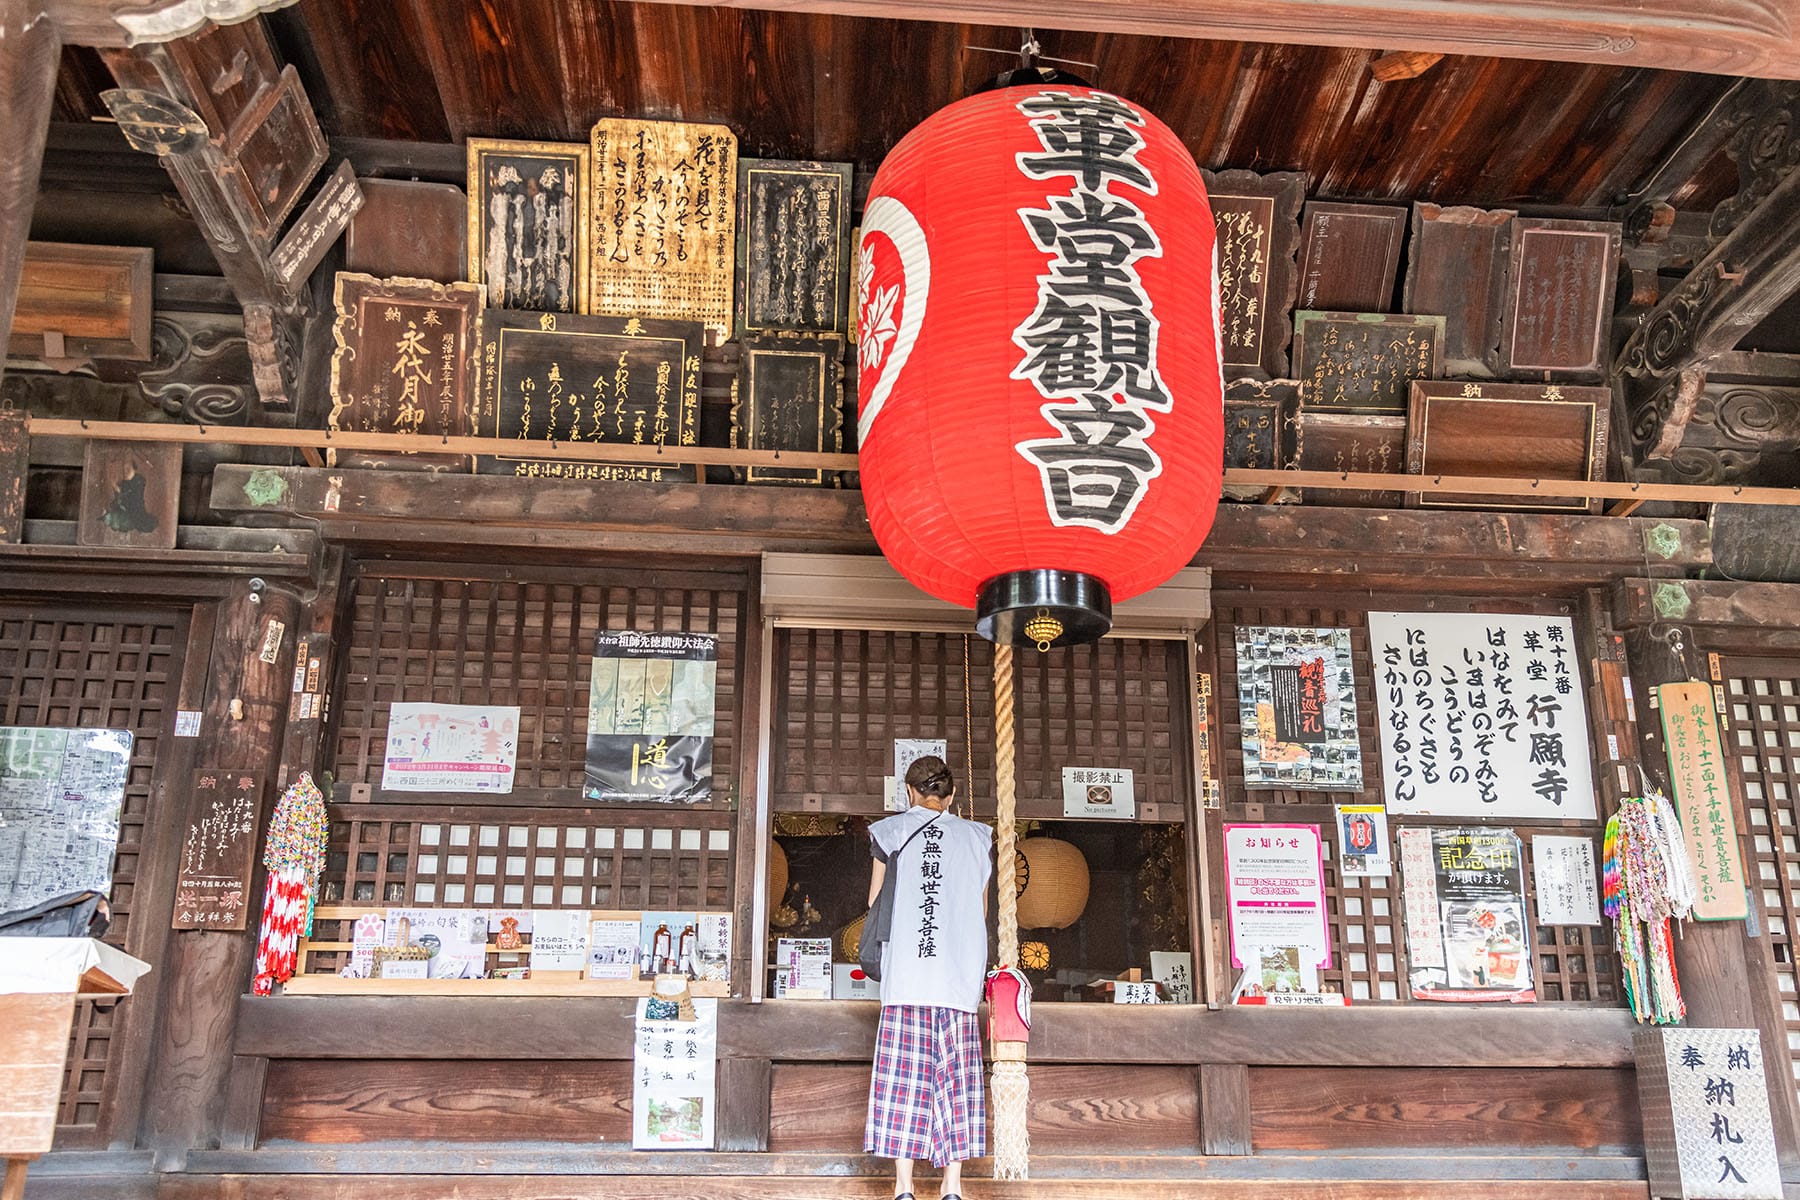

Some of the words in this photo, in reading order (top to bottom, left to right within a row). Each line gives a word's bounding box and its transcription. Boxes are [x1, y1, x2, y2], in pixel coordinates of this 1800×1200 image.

[1299, 660, 1322, 734] 観音巡礼
[1486, 626, 1520, 744] はなをみて
[1522, 631, 1548, 682] 革堂
[1545, 625, 1573, 695] 第十九番
[1382, 643, 1417, 802] さかりなるらん
[1405, 627, 1441, 785] にはのちぐさも
[1439, 664, 1470, 784] こうどうの
[1462, 647, 1499, 803] いまはのぞみも
[1525, 694, 1568, 807] 行願寺
[639, 738, 673, 790] 道心
[1073, 770, 1125, 784] 撮影禁止
[240, 800, 254, 834] 十九番
[1245, 837, 1300, 848] お知らせ
[1439, 846, 1513, 871] 記念印
[917, 823, 945, 959] 南無観世音菩薩
[1703, 1076, 1749, 1185] 納札入
